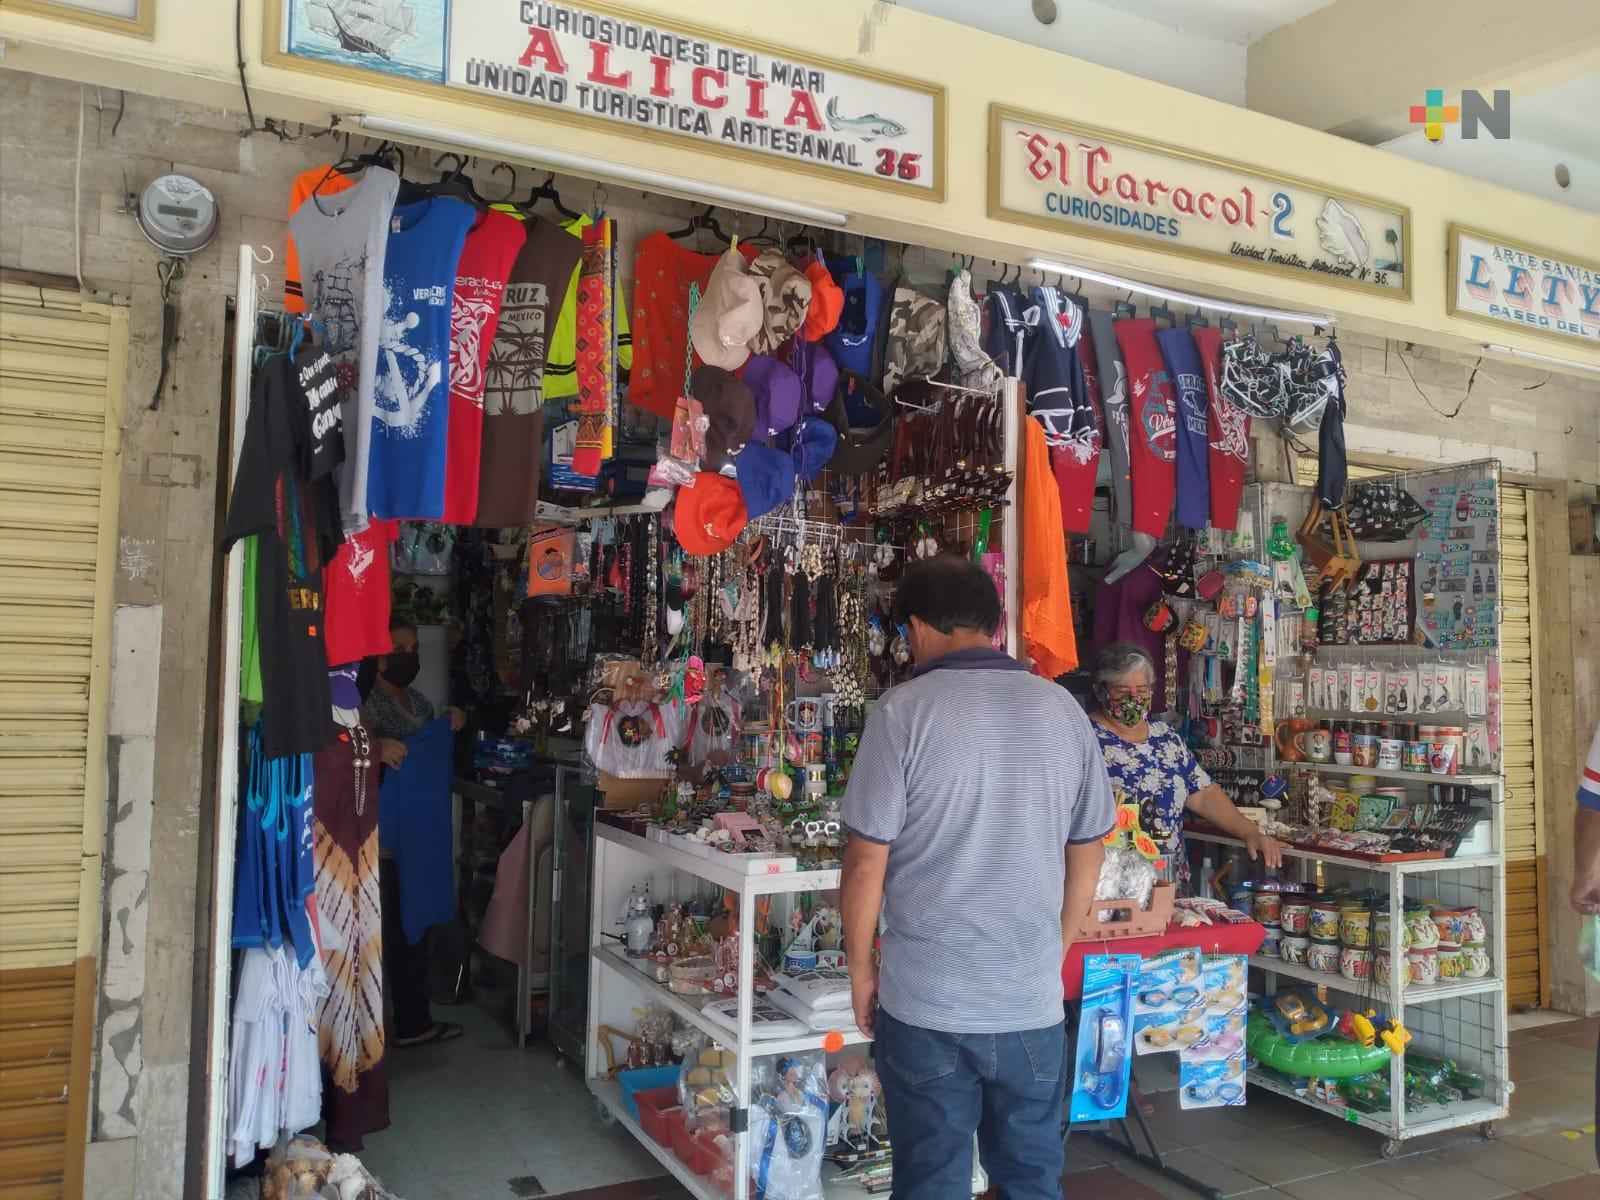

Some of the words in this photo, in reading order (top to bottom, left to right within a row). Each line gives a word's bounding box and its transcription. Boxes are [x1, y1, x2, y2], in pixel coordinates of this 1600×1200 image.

[519, 0, 710, 67] CURIOSIDADES
[717, 47, 764, 79] DEL
[771, 60, 825, 93] MAR
[518, 26, 826, 132] ALICIA
[465, 58, 568, 103] UNIDAD
[575, 82, 713, 136] TURISTICA
[720, 116, 863, 167] ARTESANAL
[1046, 191, 1182, 237] CURIOSIDADES
[1230, 241, 1265, 261] Unidad
[1491, 246, 1600, 284] ARTESANIAS
[508, 311, 542, 321] MEXICO
[1489, 304, 1550, 327] PASEO
[1557, 319, 1590, 336] DEL
